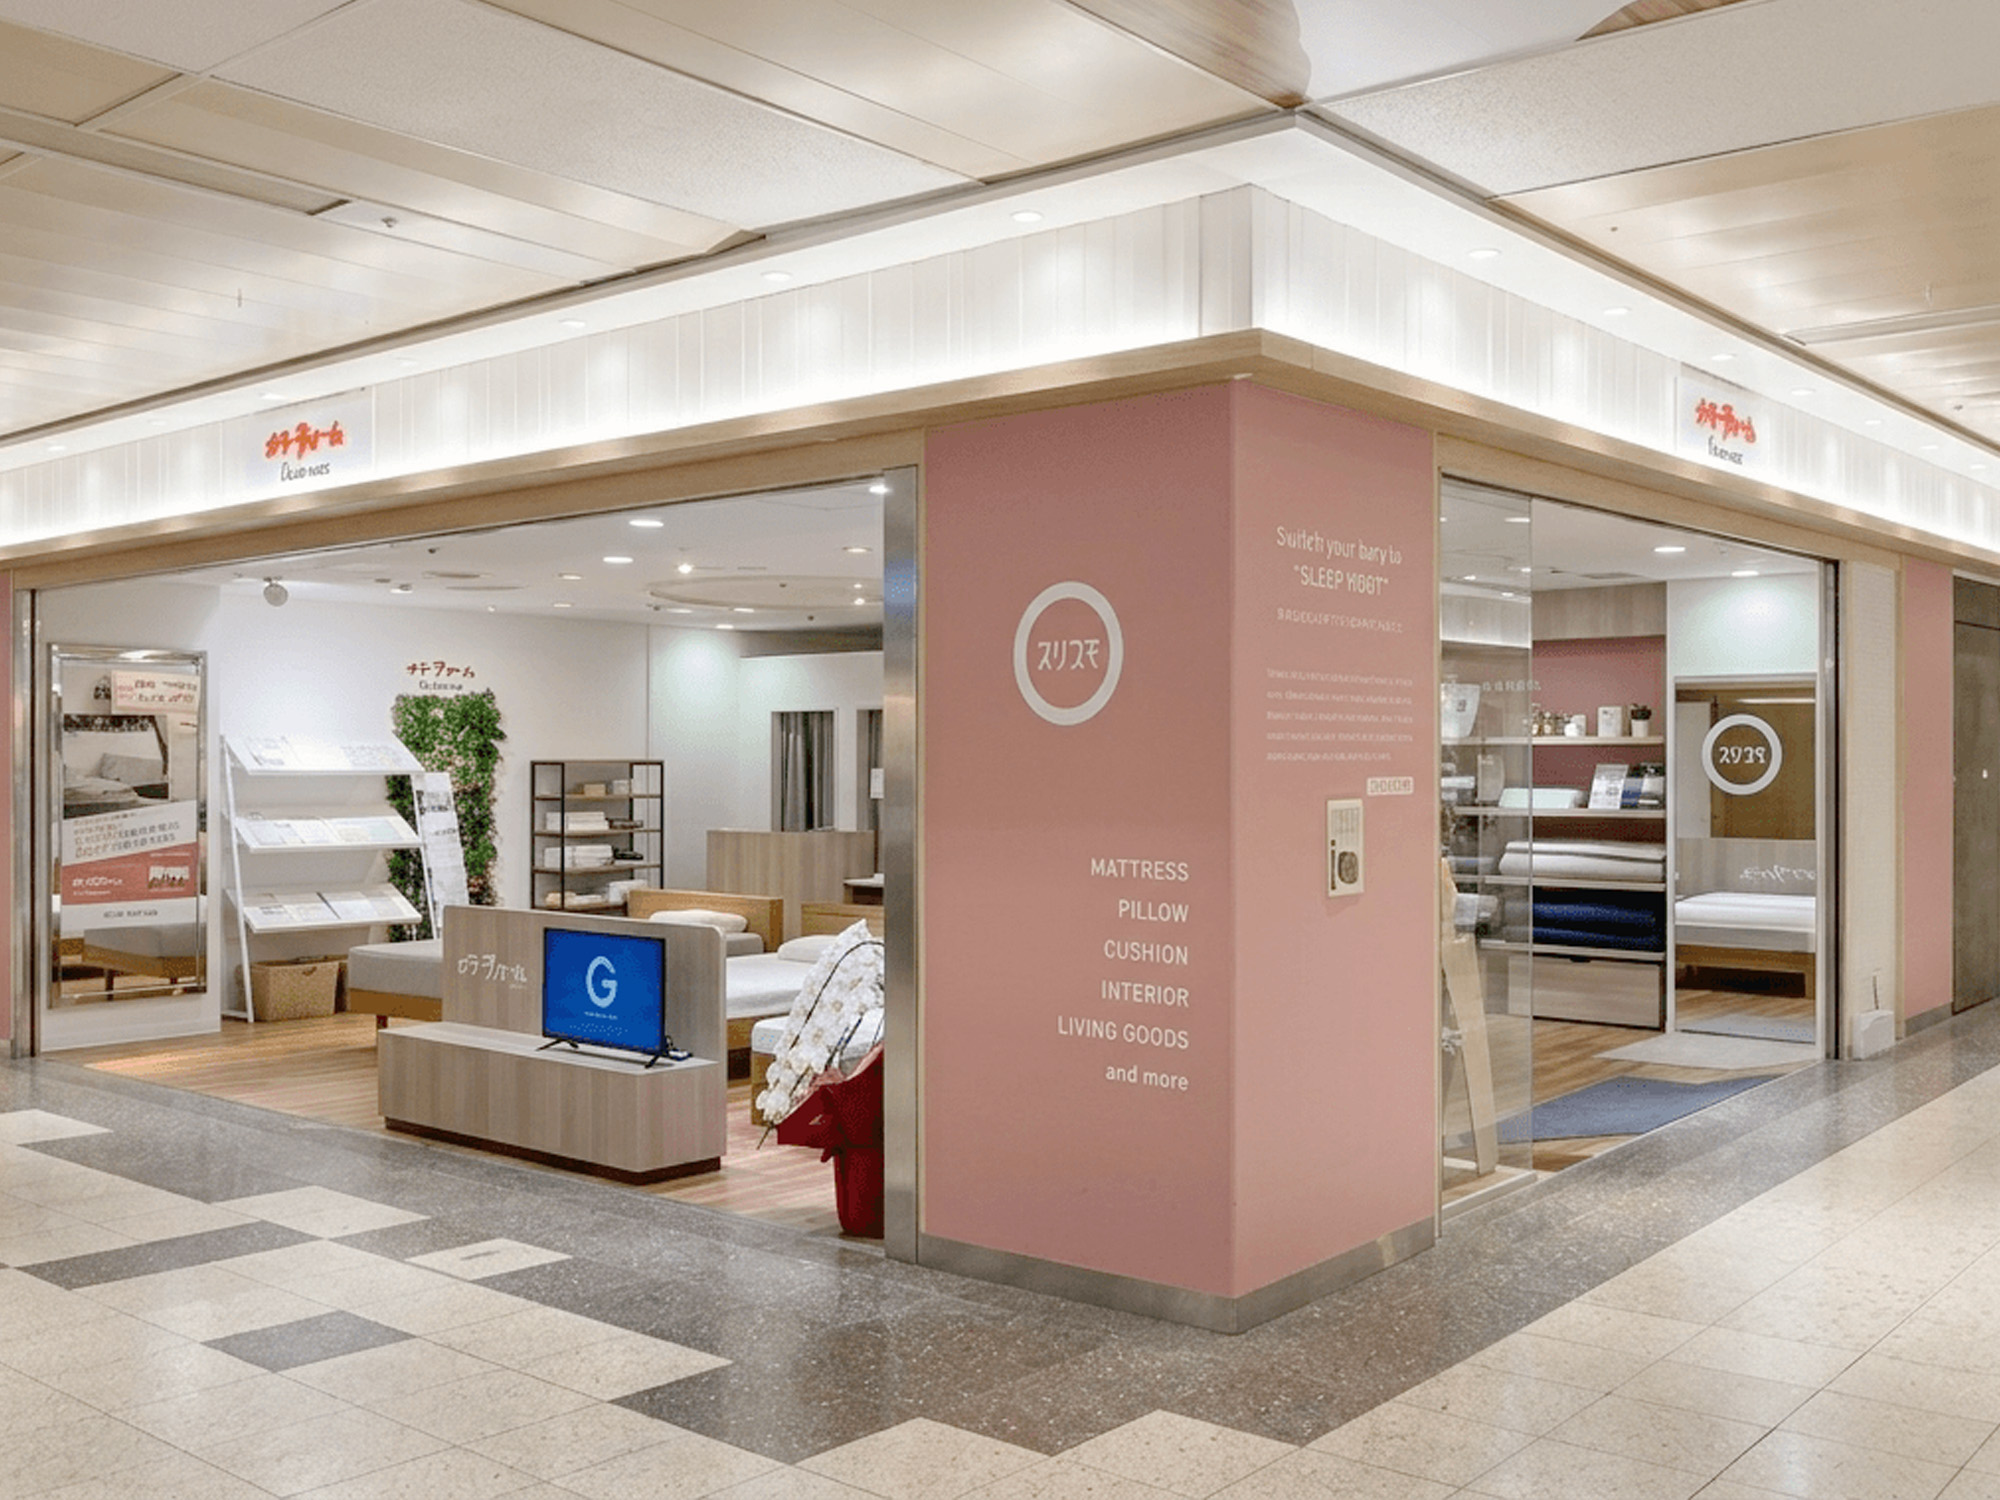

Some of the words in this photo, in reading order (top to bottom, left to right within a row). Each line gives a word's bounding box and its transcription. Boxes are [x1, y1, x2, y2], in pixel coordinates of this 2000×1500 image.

[1090, 857, 1189, 883] MATTRESS
[1117, 898, 1189, 923] PILLOW
[1103, 938, 1189, 966] CUSHION
[585, 955, 618, 1009] G
[1100, 979, 1189, 1008] INTERIOR
[1057, 1015, 1117, 1042] LIVING
[1122, 1023, 1189, 1050] GOODS
[1105, 1064, 1138, 1084] and
[1143, 1070, 1189, 1091] more
